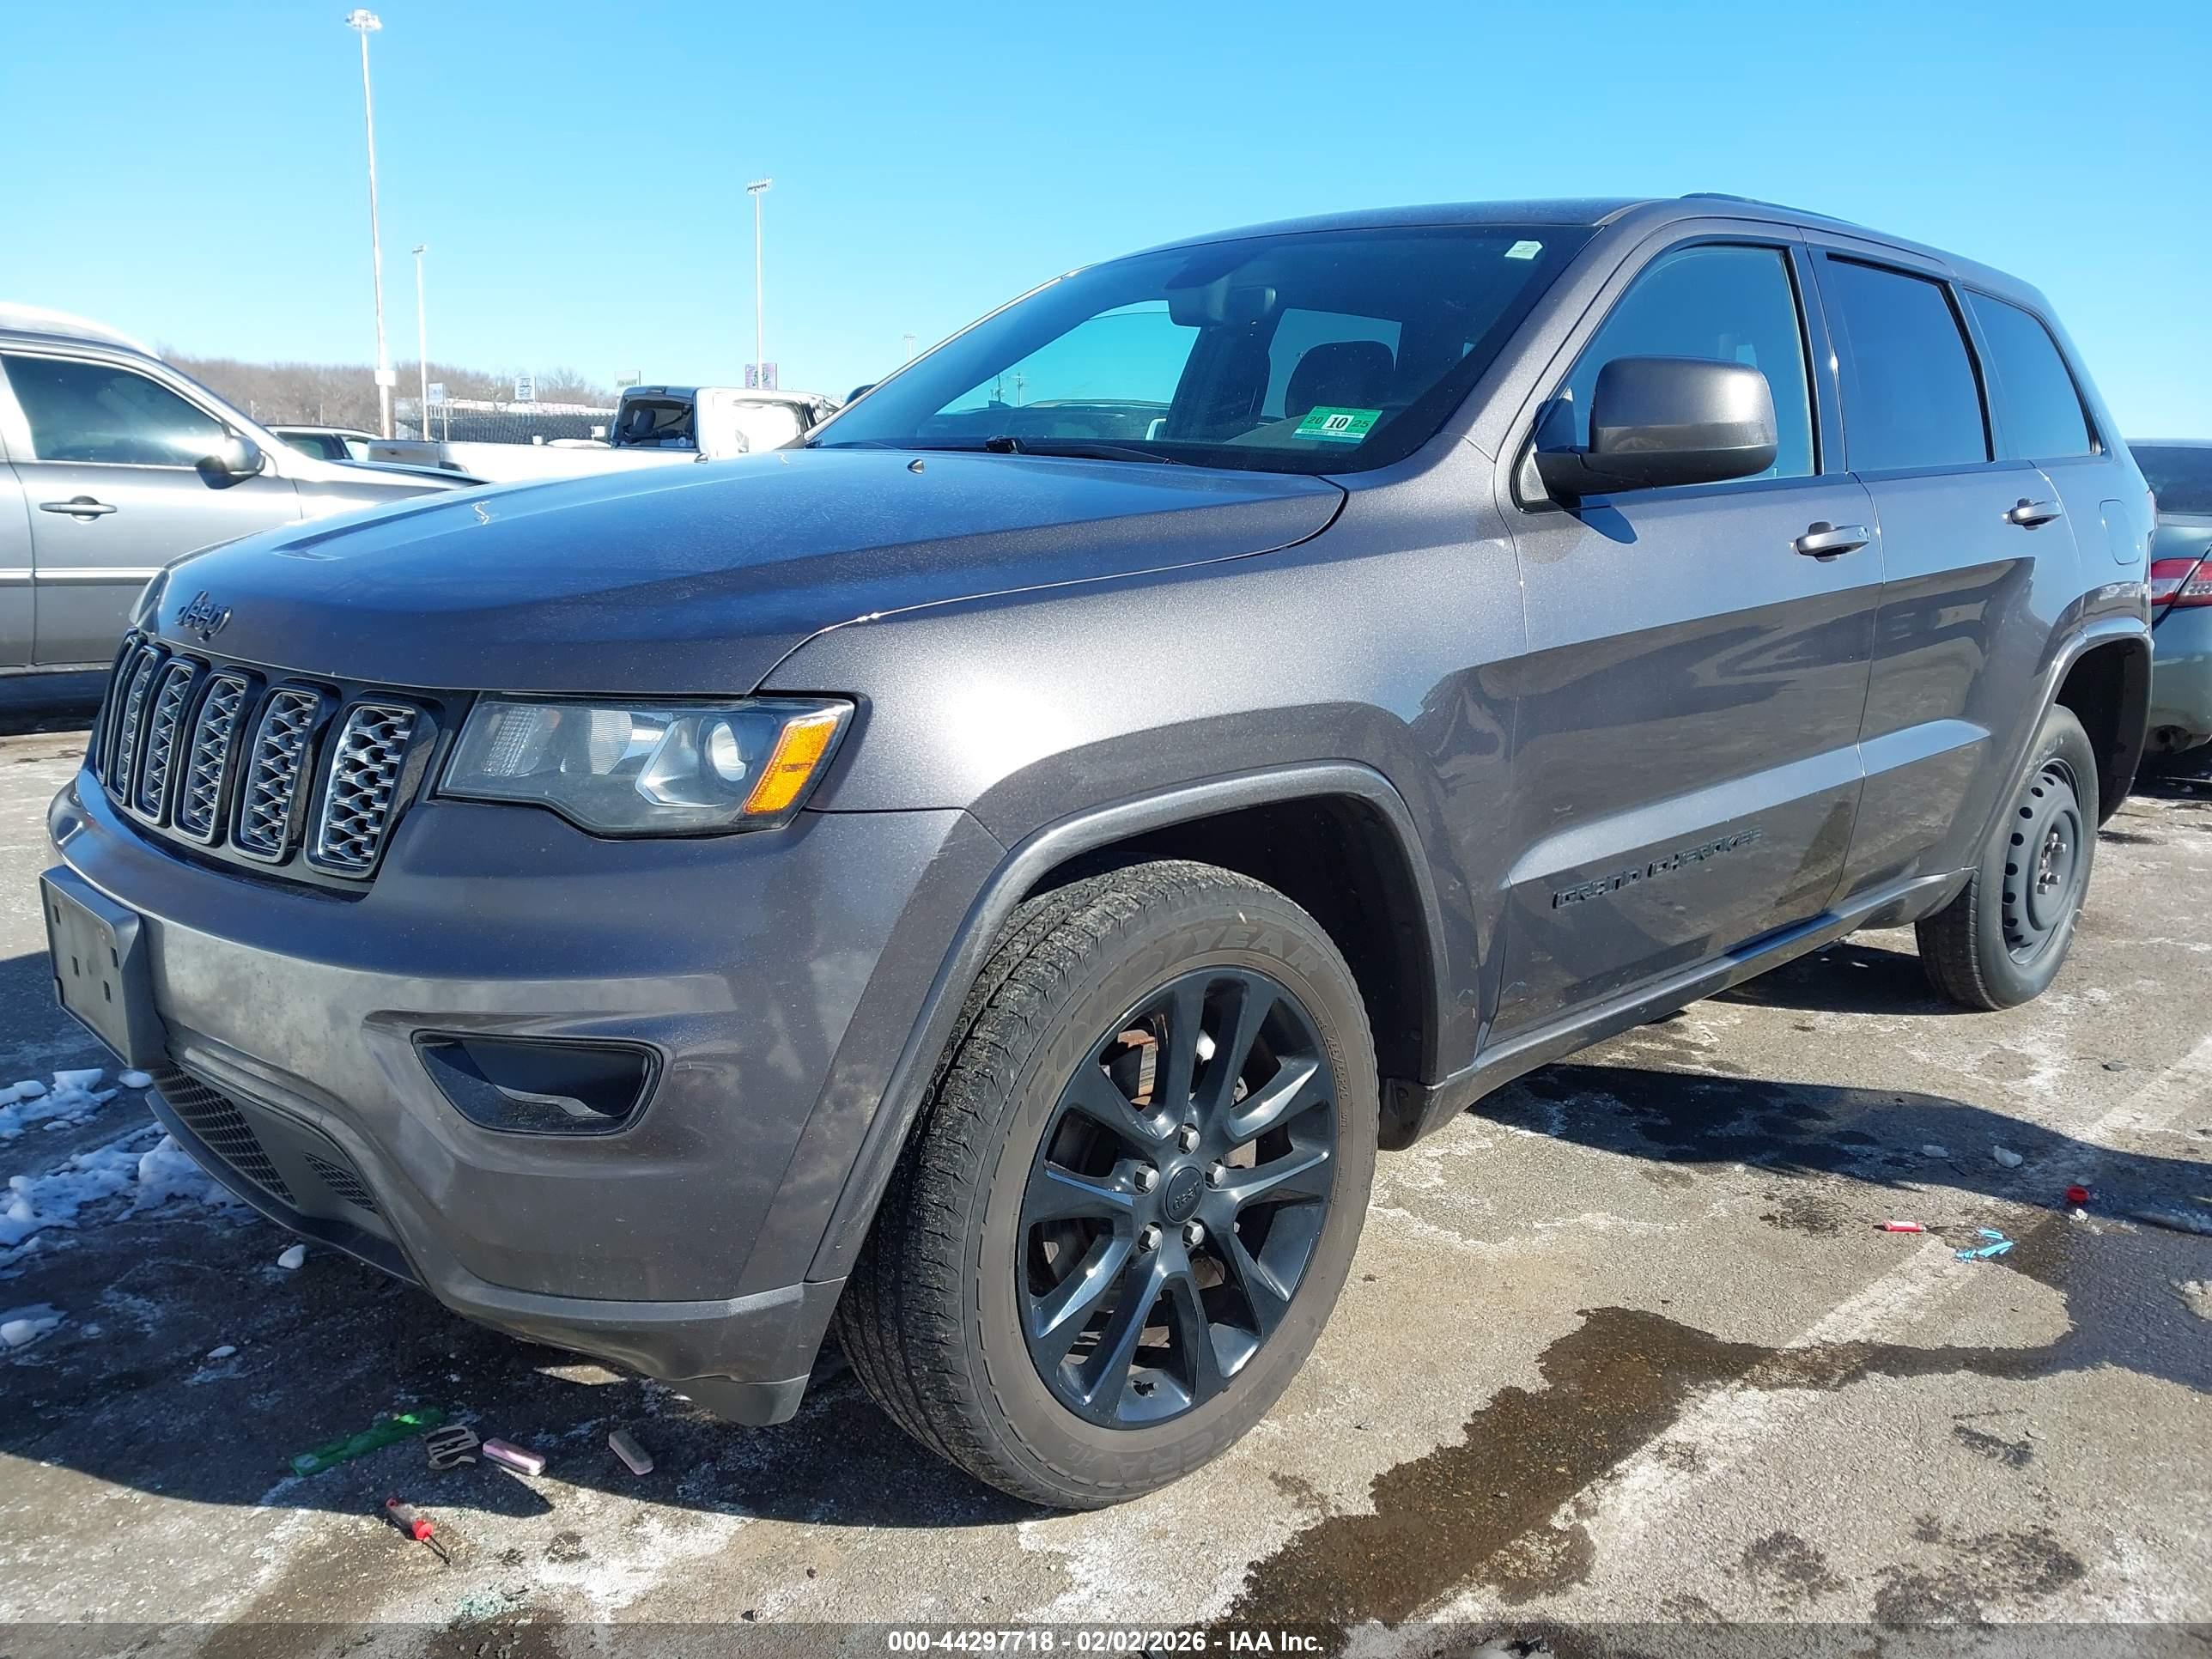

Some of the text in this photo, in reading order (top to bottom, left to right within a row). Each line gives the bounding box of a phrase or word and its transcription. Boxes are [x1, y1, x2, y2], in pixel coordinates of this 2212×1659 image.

[1307, 416, 1370, 428] 20 10 25
[173, 590, 233, 641] Jeep
